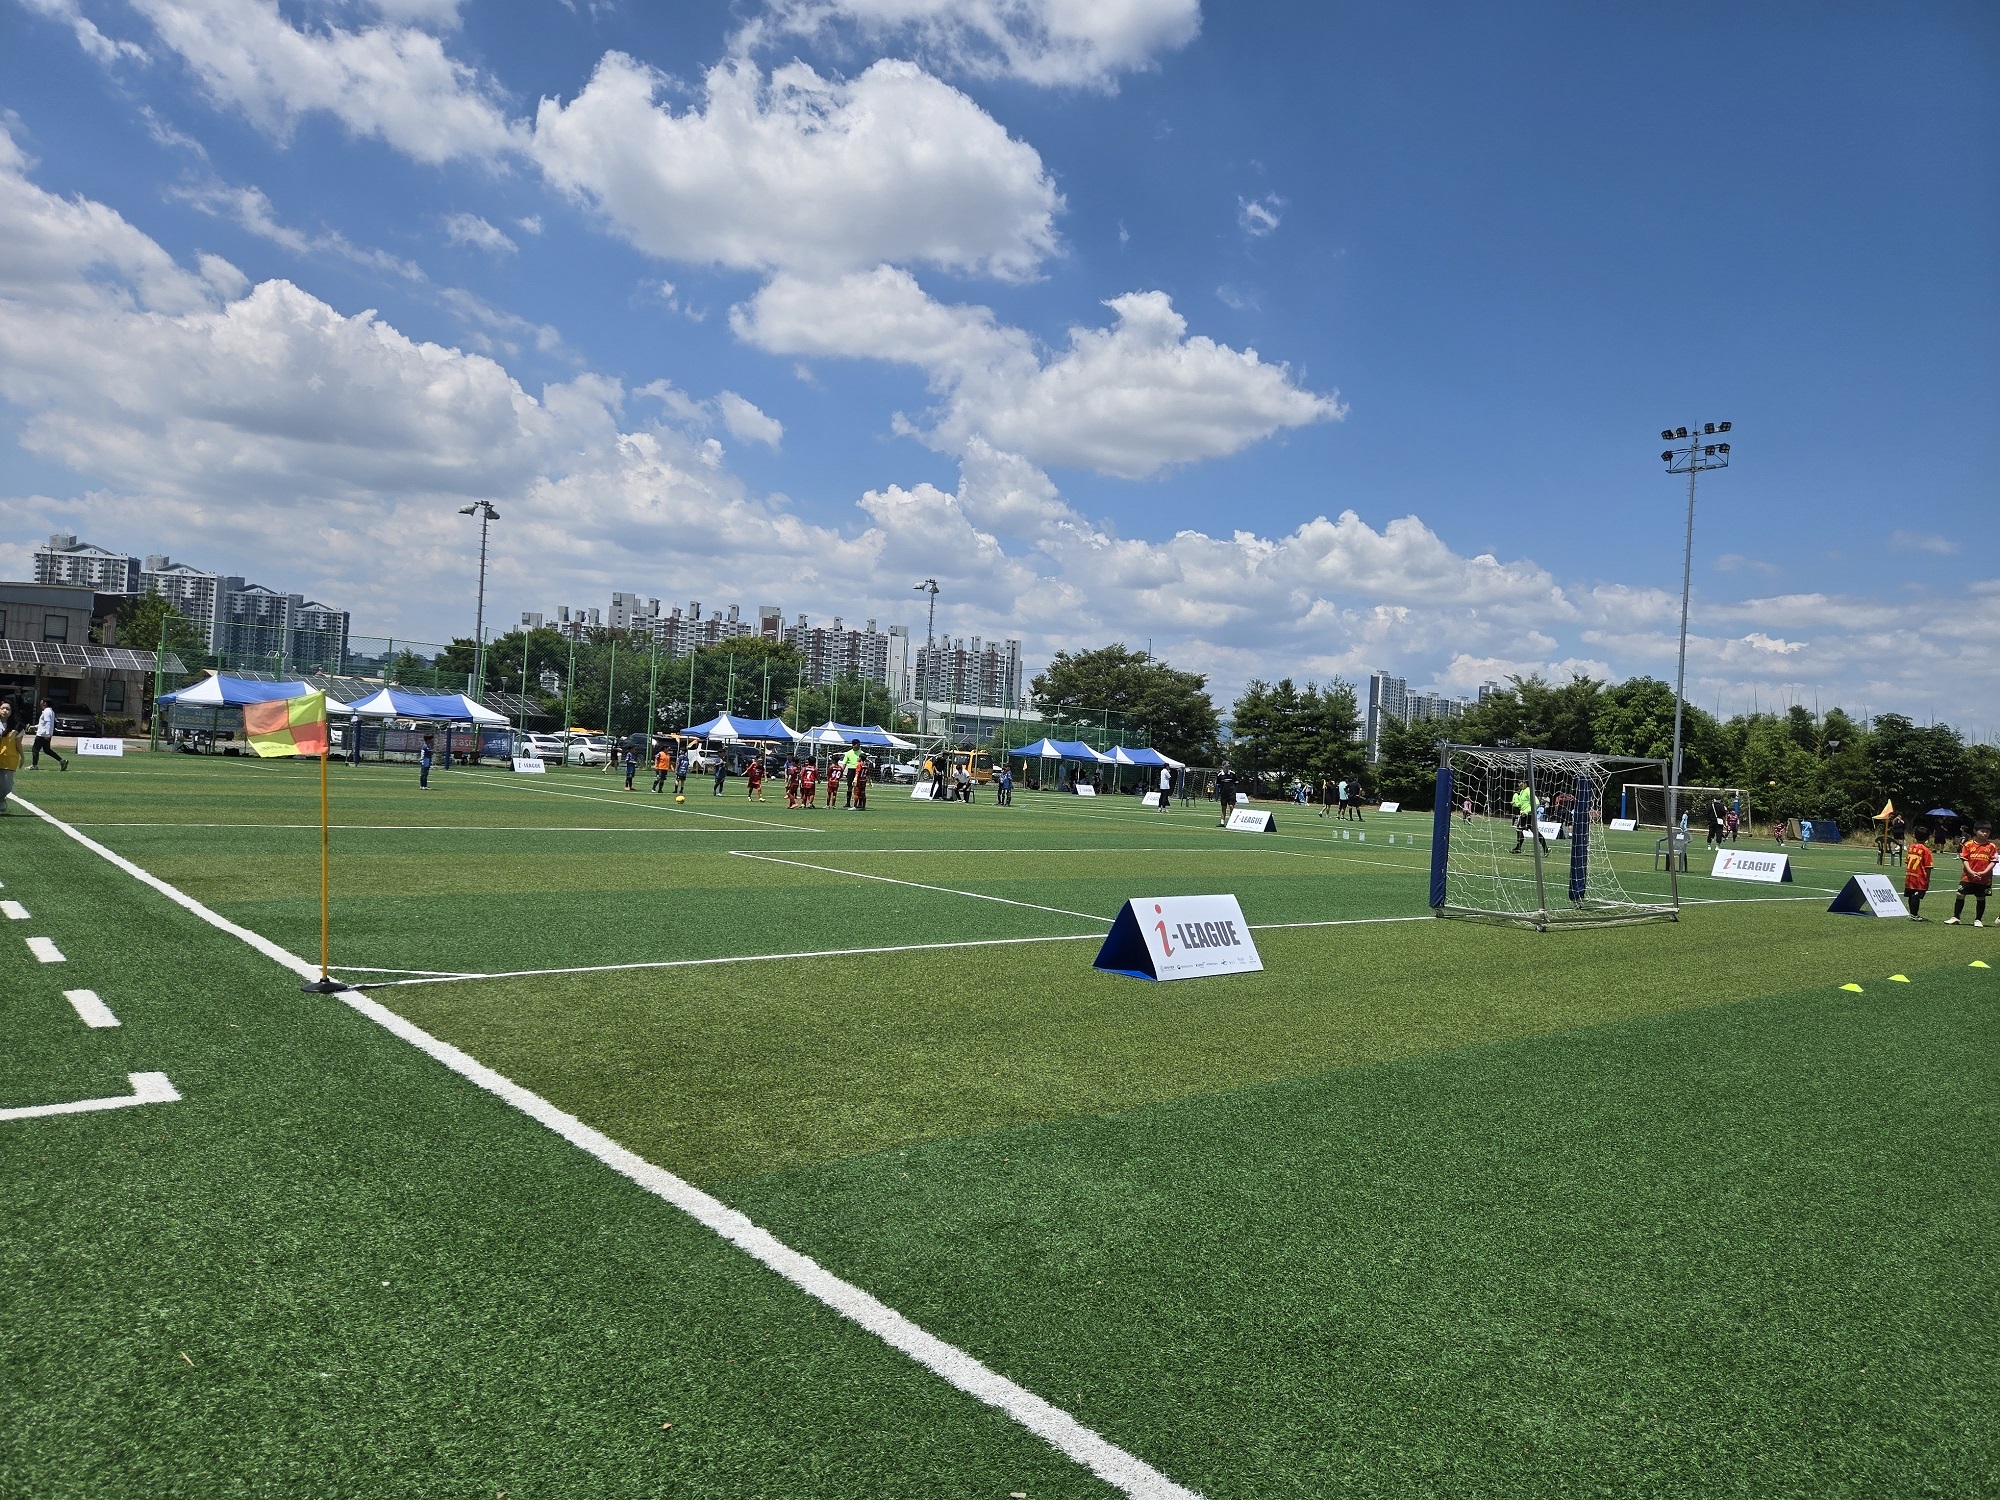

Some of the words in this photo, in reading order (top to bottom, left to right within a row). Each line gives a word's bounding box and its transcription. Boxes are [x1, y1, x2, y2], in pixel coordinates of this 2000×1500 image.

[84, 739, 118, 751] i-LEAGUE
[1233, 811, 1264, 825] i-LEAGUE
[1723, 852, 1777, 873] i-LEAGUE
[1907, 853, 1922, 870] 77
[1154, 903, 1242, 958] i-LEAGUE
